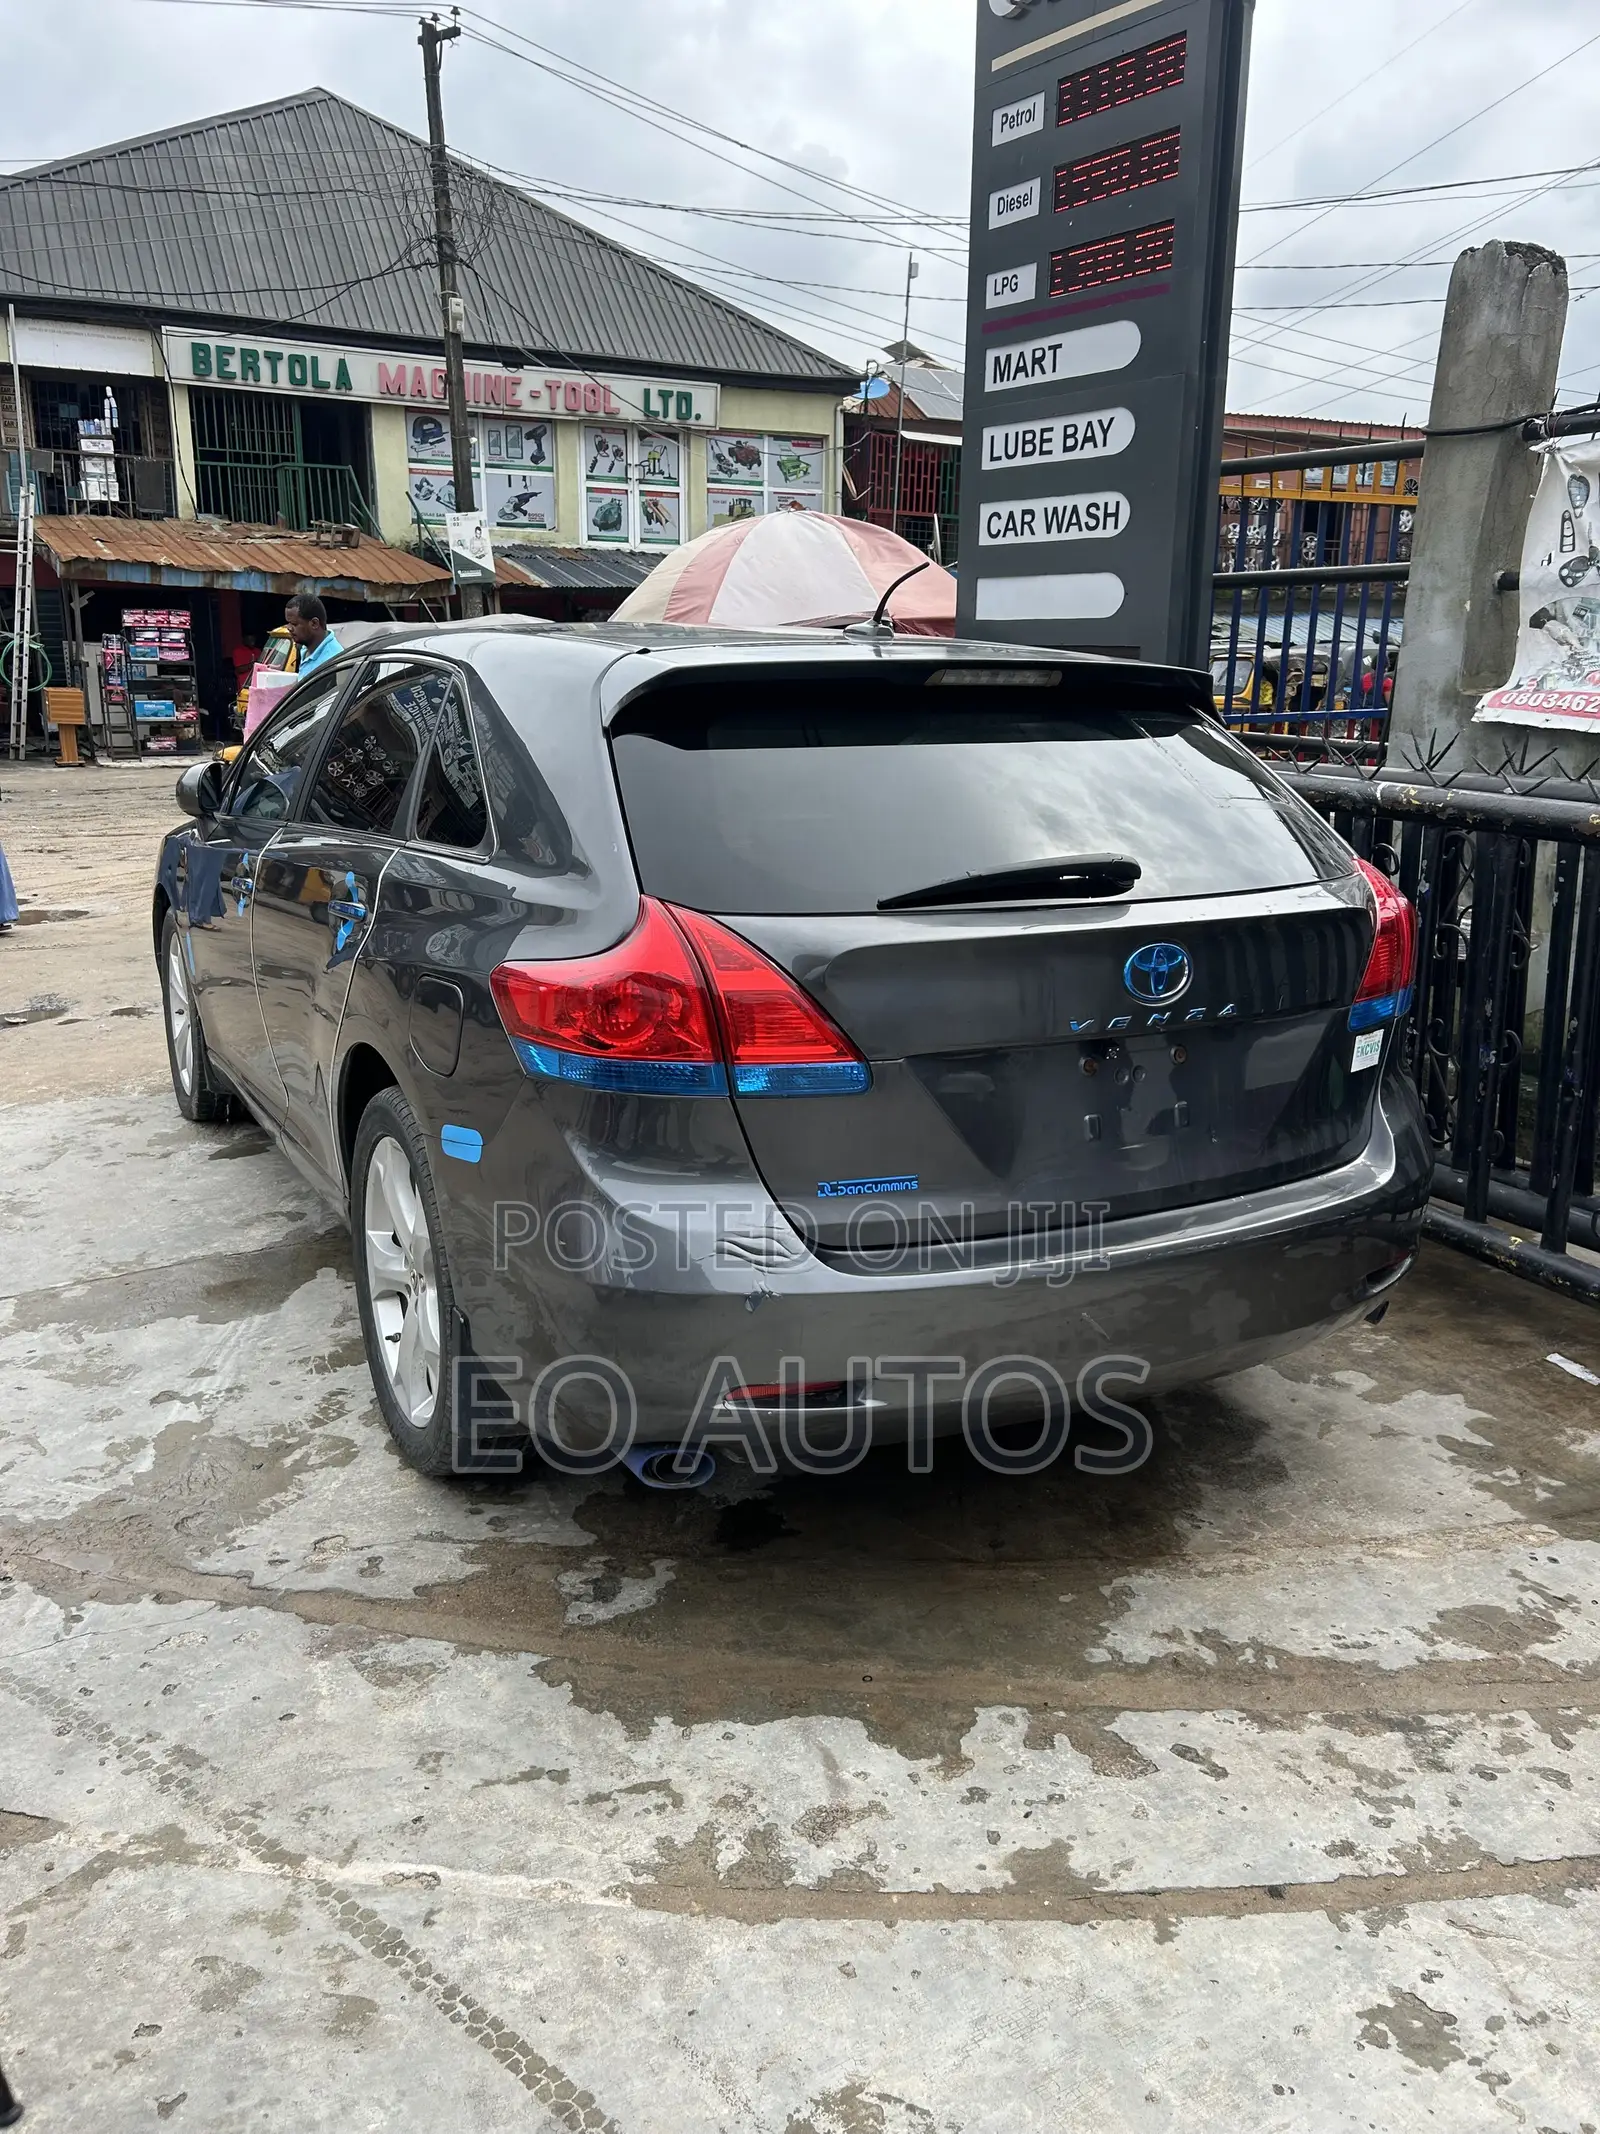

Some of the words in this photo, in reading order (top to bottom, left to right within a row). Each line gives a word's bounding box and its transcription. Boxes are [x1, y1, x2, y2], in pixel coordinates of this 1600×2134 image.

[1000, 102, 1036, 133] Petrol
[997, 187, 1033, 216] Diesel
[993, 274, 1019, 297] LPG
[993, 343, 1063, 384] MART
[191, 342, 353, 390] BERTOLA
[378, 362, 620, 415] MACINE-TOOL
[643, 388, 701, 421] LTD.
[989, 426, 1054, 462] LUBE
[1062, 416, 1115, 453] BAY
[987, 508, 1036, 539] CAR
[1044, 500, 1121, 535] WASH
[1069, 1003, 1237, 1033] VENZA
